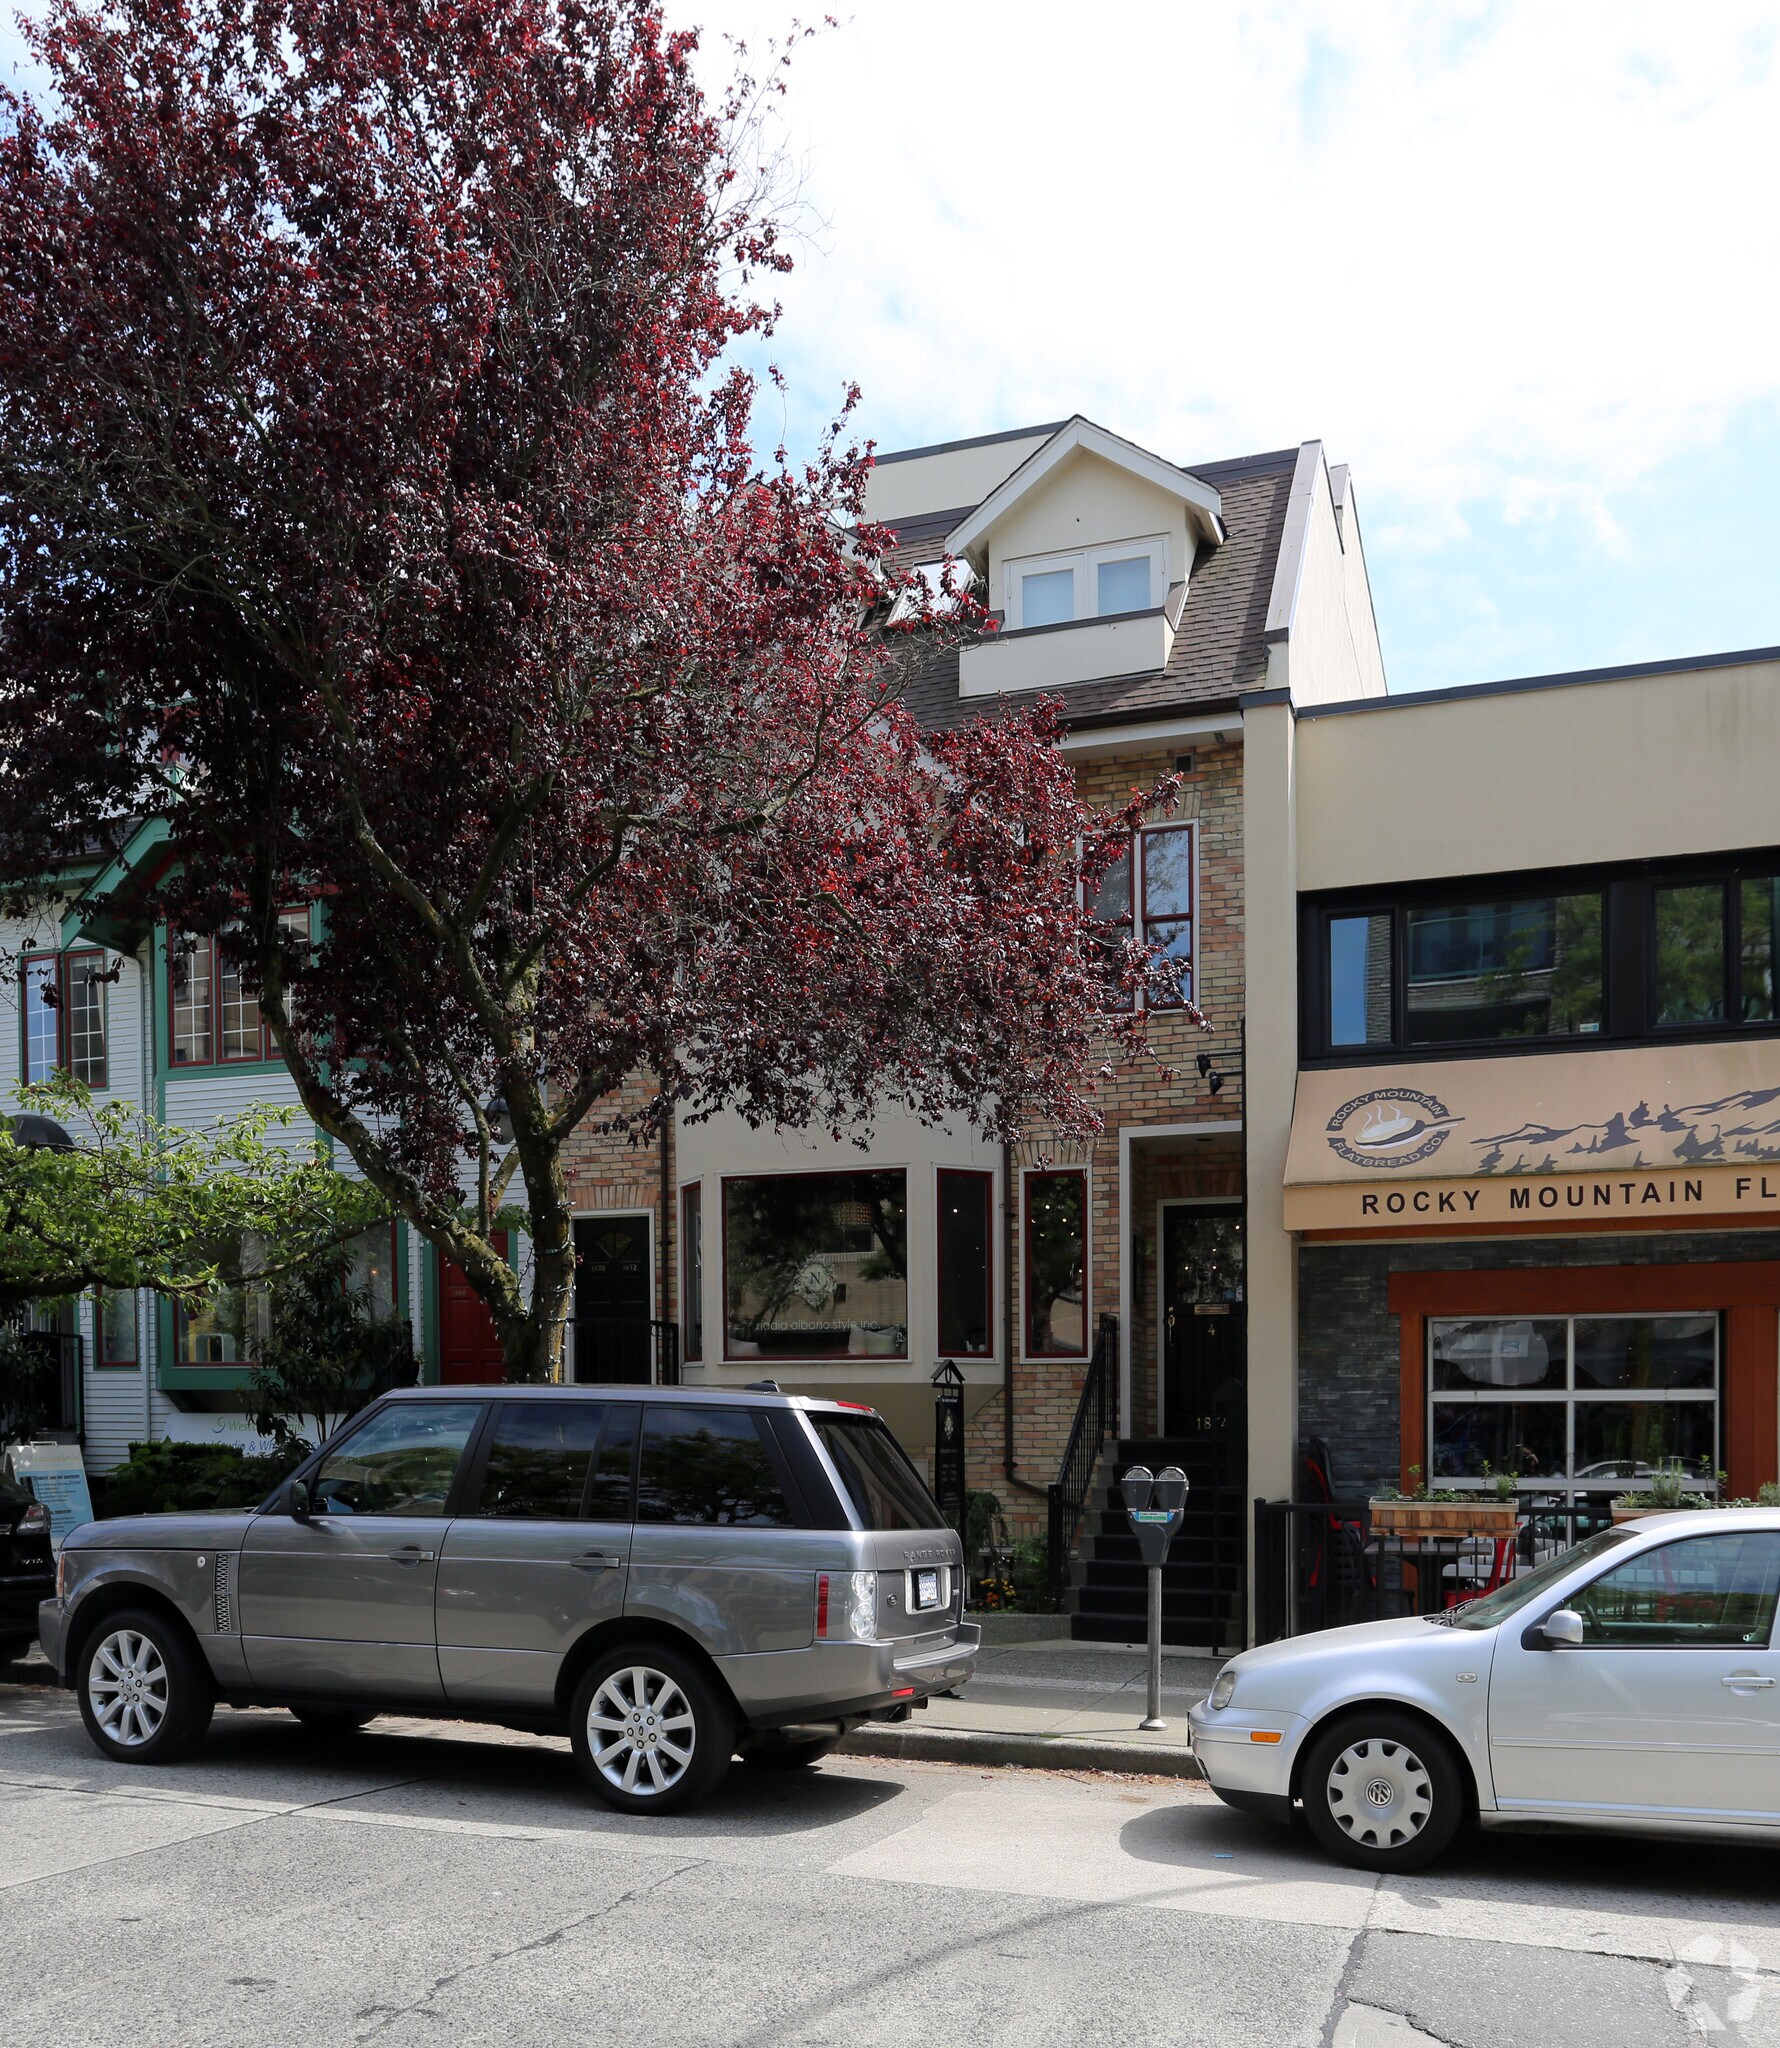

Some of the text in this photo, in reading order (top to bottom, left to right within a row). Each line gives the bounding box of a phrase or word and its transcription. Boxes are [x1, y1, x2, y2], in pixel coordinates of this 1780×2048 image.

[1331, 1090, 1444, 1127] ROCKY MOUNTAIN
[1333, 1134, 1445, 1167] FLATBREAD CO.
[1362, 1177, 1778, 1215] ROCKY MOUNTAIN FL
[810, 1271, 821, 1285] N
[756, 1319, 788, 1331] nadia
[790, 1319, 831, 1331] albano
[833, 1319, 858, 1332] style
[1207, 1323, 1216, 1336] 4
[248, 1440, 257, 1452] &
[903, 1550, 933, 1560] RANGE
